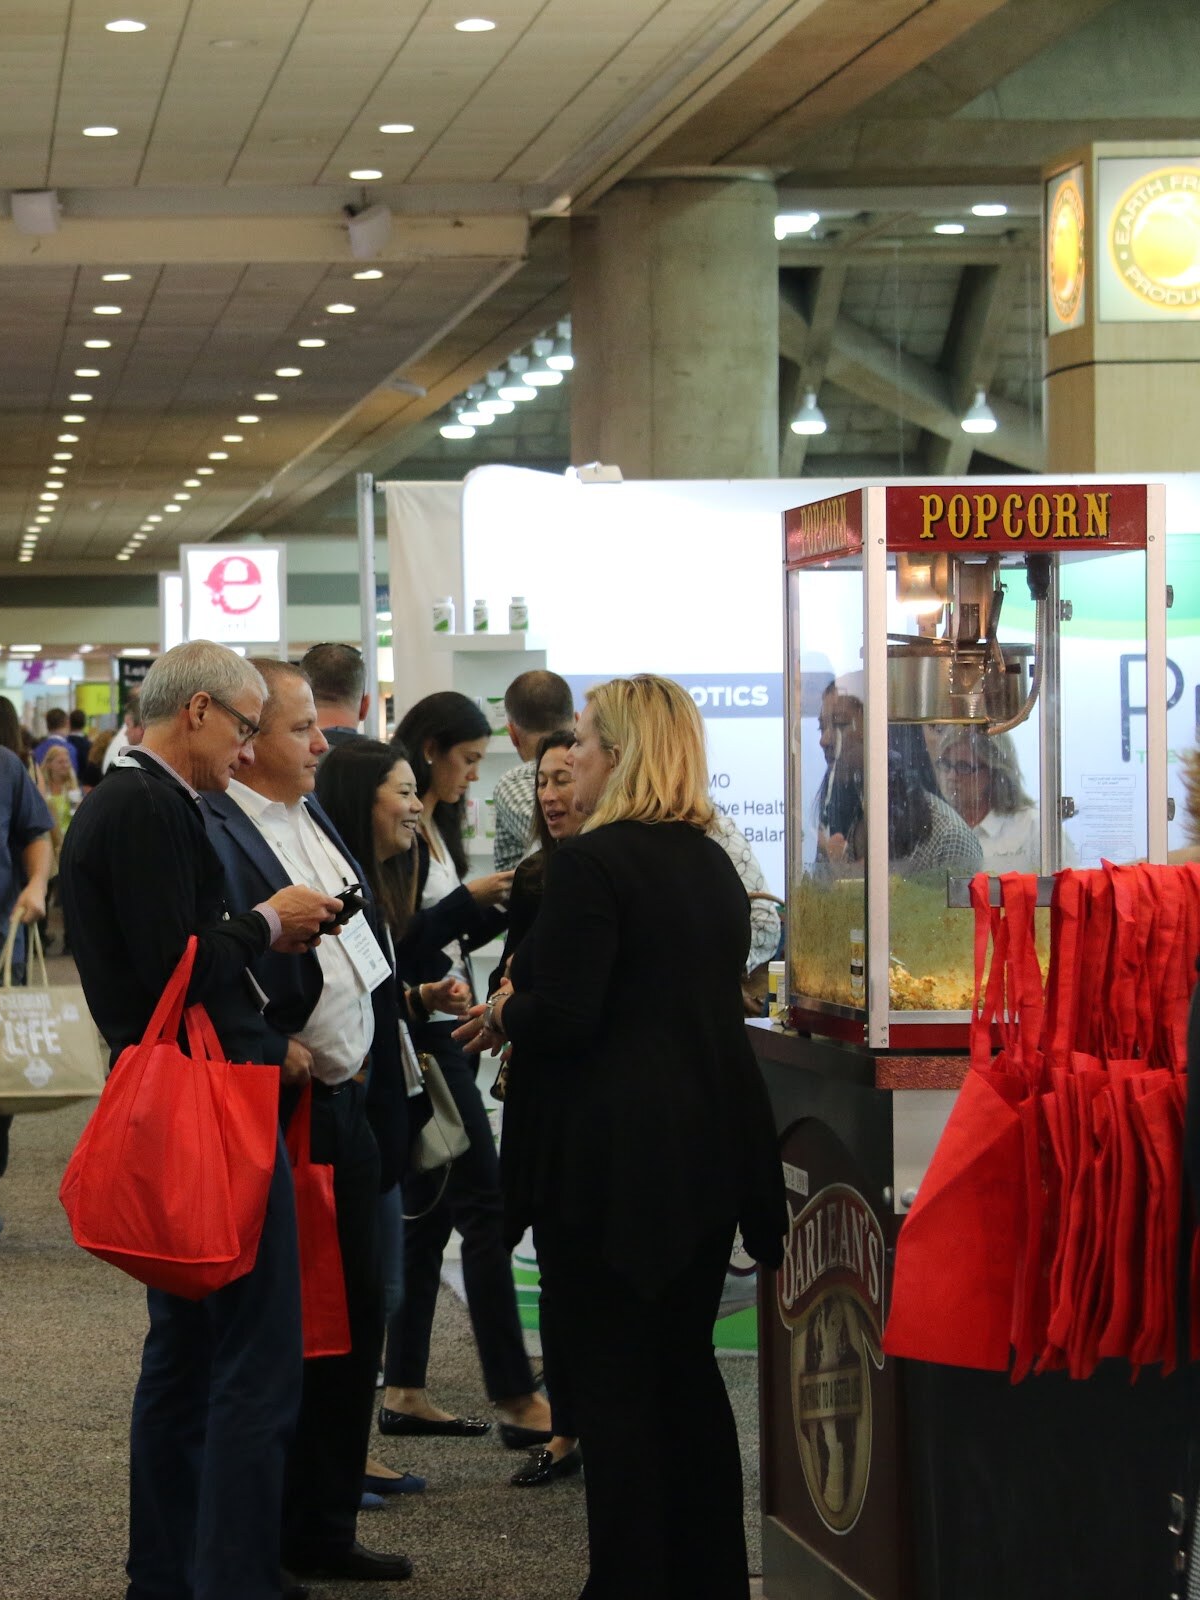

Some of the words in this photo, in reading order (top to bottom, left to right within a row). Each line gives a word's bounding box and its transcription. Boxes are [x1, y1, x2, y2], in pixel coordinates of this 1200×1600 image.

[1115, 178, 1165, 245] EARTH
[1125, 263, 1200, 305] PRODU
[800, 496, 848, 556] POPCORN
[919, 492, 1112, 539] POPCORN
[688, 685, 769, 707] OTICS
[743, 799, 784, 815] Healt
[782, 1199, 879, 1310] BARLEAN'S
